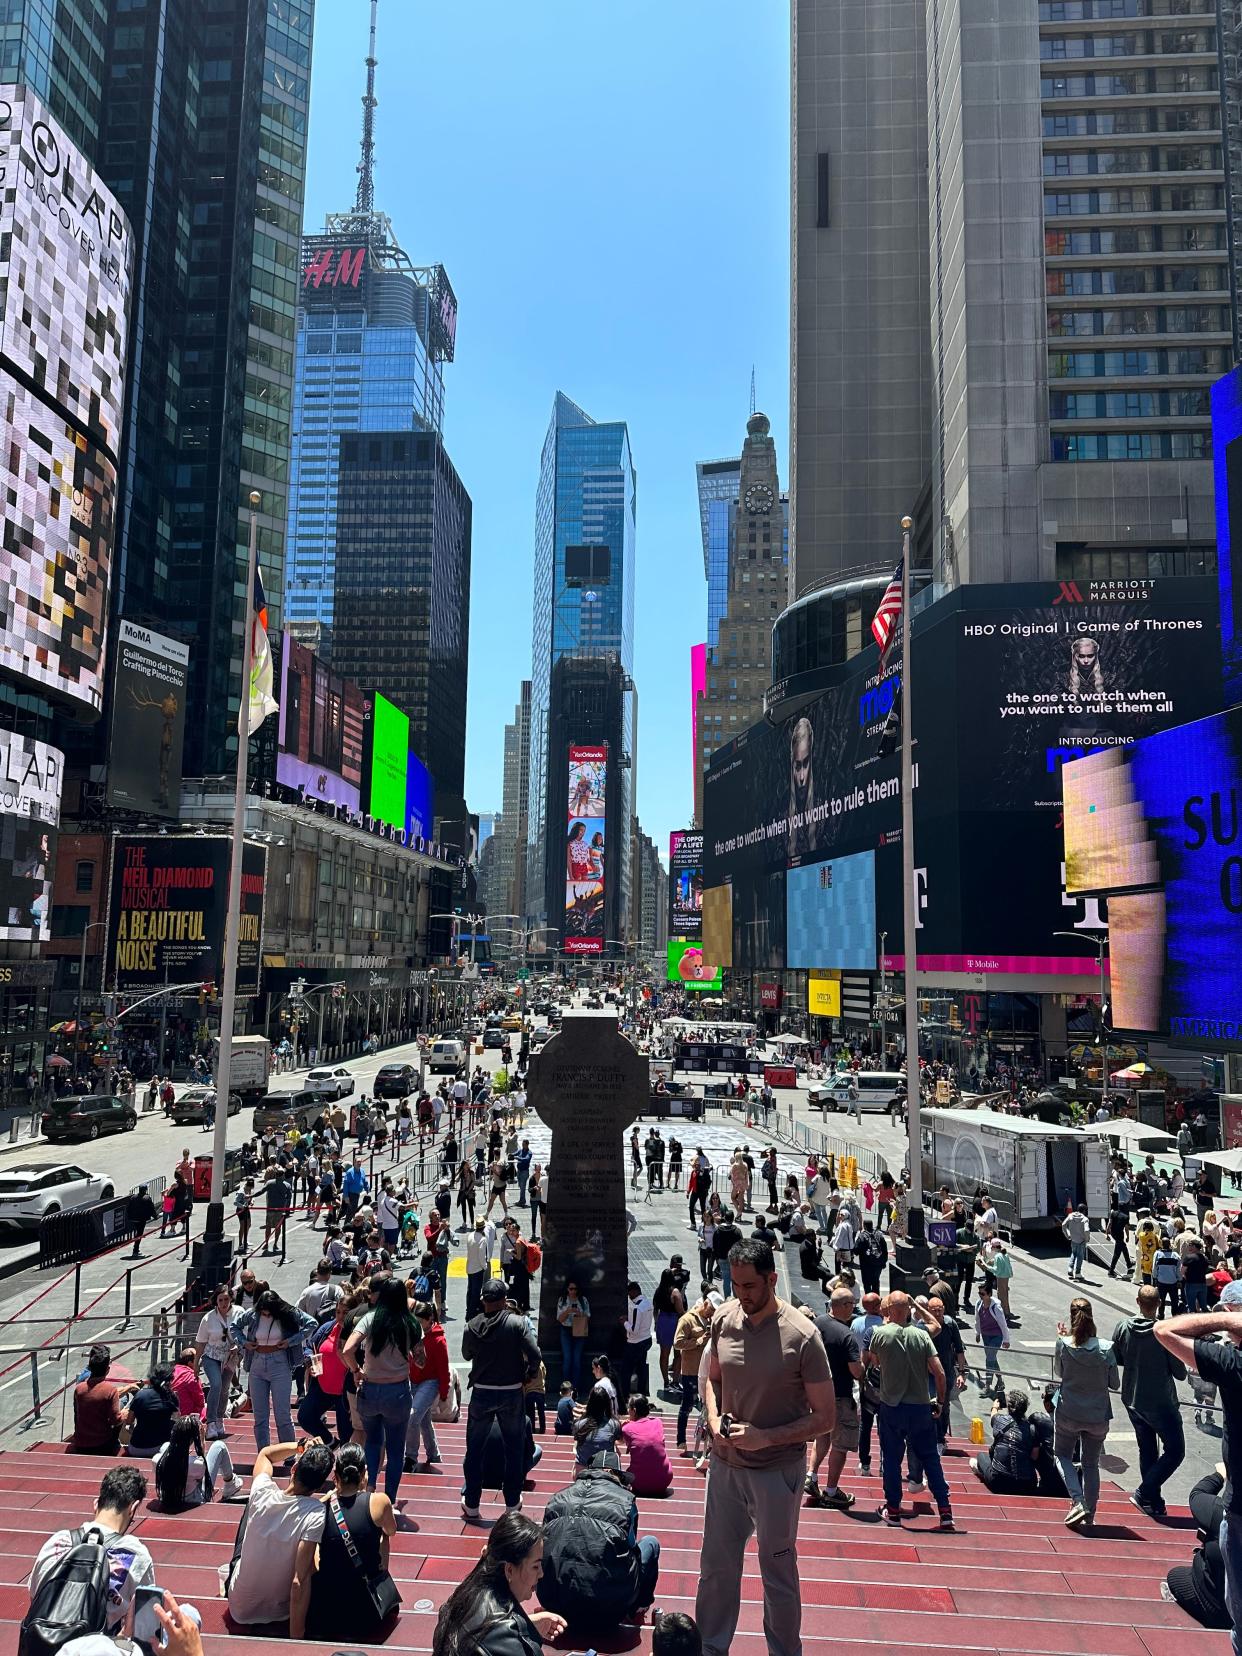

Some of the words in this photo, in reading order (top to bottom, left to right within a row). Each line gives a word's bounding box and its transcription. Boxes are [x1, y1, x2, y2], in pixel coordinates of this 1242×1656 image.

[24, 165, 95, 260] DISCOVER
[305, 248, 366, 289] H&M
[1090, 580, 1156, 590] MARRIOTT
[1090, 591, 1149, 600] MARQUIS
[125, 625, 151, 644] MoMA
[1000, 622, 1058, 637] Original
[1077, 621, 1120, 632] Game
[1125, 620, 1140, 631] of
[1144, 619, 1203, 630] Thrones
[122, 658, 151, 677] Crafting
[152, 668, 183, 687] Pinocchio
[123, 648, 157, 667] Guillermo
[157, 662, 168, 671] del
[168, 665, 184, 678] Toro:
[1006, 692, 1030, 704] the
[1033, 693, 1059, 703] one
[1061, 692, 1077, 702] to
[1079, 690, 1124, 702] watch
[1127, 690, 1166, 701] when
[999, 705, 1025, 718] you
[1028, 704, 1065, 715] want
[1067, 703, 1083, 714] to
[1086, 702, 1113, 714] rule
[1116, 702, 1154, 713] them
[1155, 700, 1173, 713] all
[1059, 736, 1135, 745] INTRODUCING
[0, 790, 36, 816] OVER
[715, 841, 724, 856] the
[725, 838, 736, 851] one
[737, 834, 744, 848] to
[744, 823, 766, 845] watch
[767, 818, 787, 839] when
[788, 812, 803, 836] you
[805, 800, 829, 825] want
[831, 798, 842, 816] to
[844, 787, 864, 812] rule
[867, 776, 900, 804] them
[125, 847, 147, 867] THE
[122, 868, 150, 888] NEIL
[153, 868, 214, 888] DIAMOND
[121, 888, 171, 908] MUSICAL
[117, 911, 127, 940] A
[131, 911, 206, 940] BEAUTIFUL
[115, 941, 158, 970] NOISE
[974, 960, 1000, 969] Mobile
[872, 1010, 899, 1022] SEPORA
[552, 1072, 586, 1081] FRANCIS
[597, 1073, 626, 1082] DUFFY
